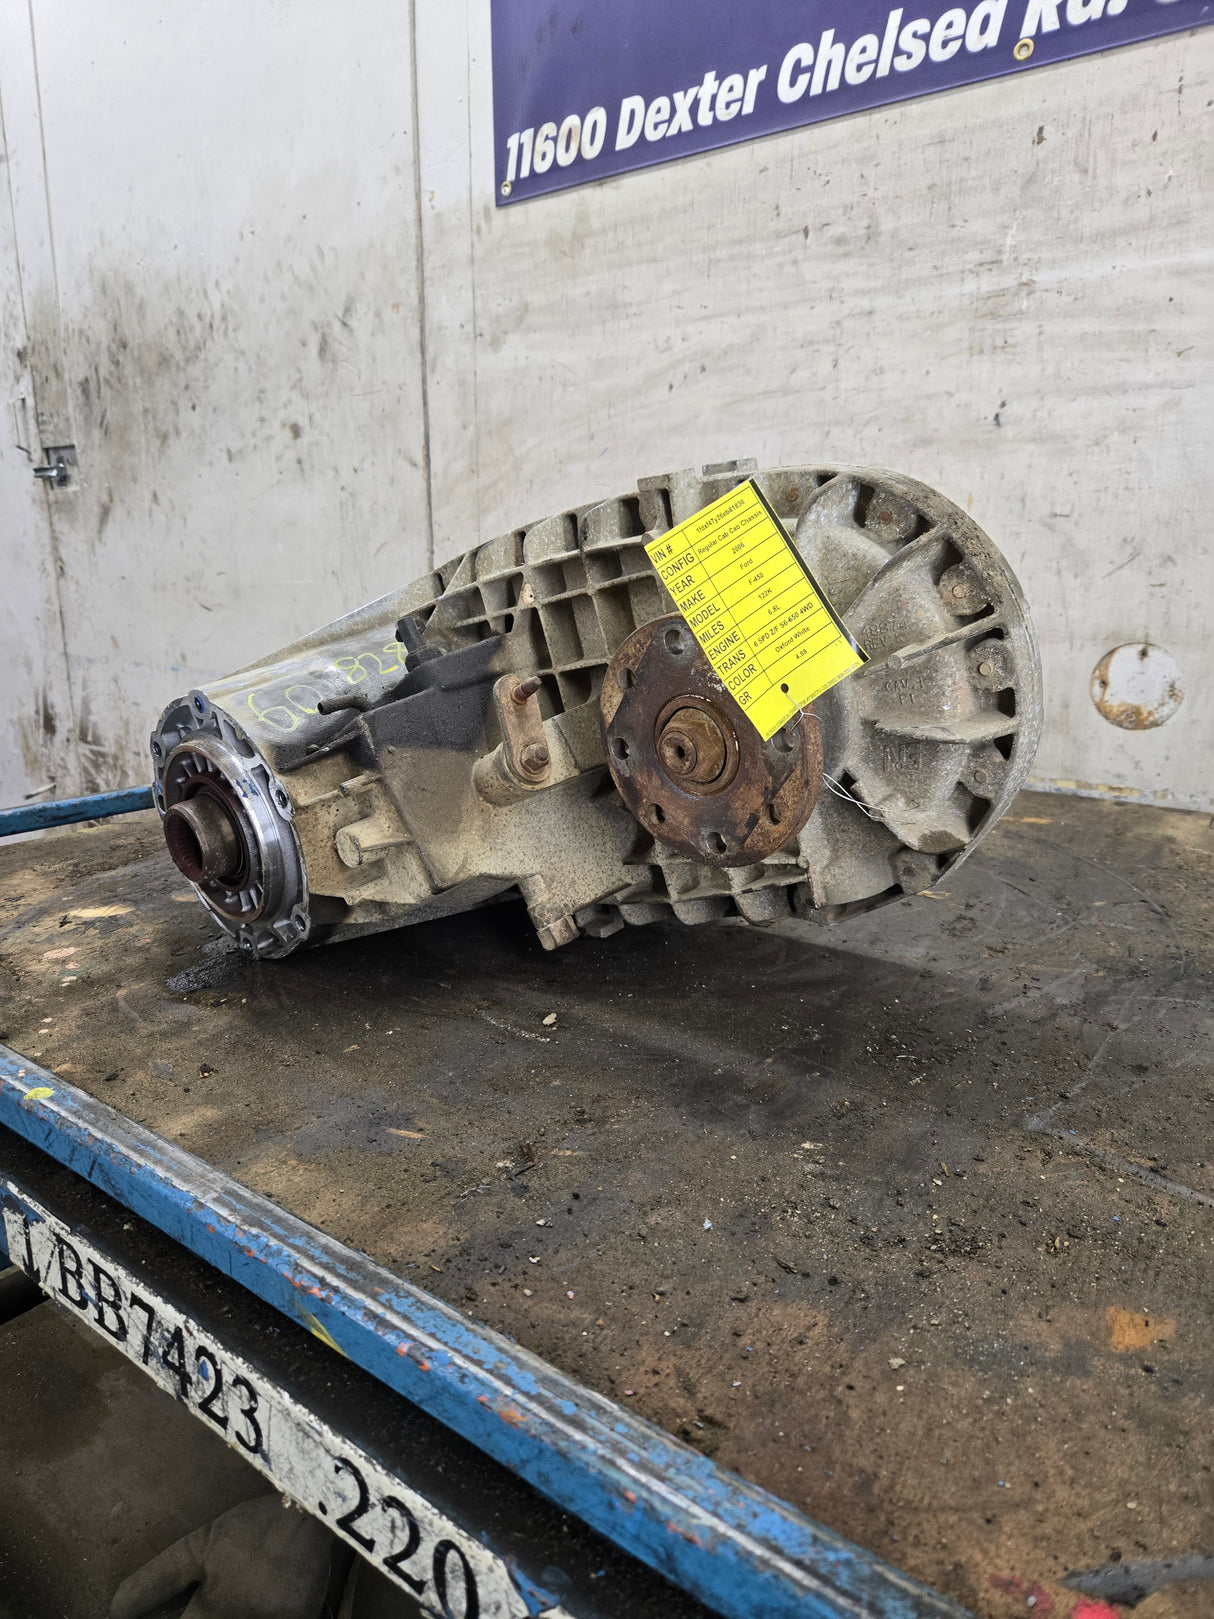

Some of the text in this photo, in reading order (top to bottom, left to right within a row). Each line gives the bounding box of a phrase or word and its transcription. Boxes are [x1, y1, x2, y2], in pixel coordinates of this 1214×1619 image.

[505, 106, 607, 183] 11600
[615, 64, 768, 152] Dexter
[776, 0, 1008, 104] Chelsea
[697, 510, 762, 555] Regular Cab Cab Chassis
[650, 543, 673, 565] VIN #
[731, 541, 745, 555] 2006
[660, 552, 695, 581] CONFIG
[739, 558, 754, 570] Ford
[670, 574, 695, 596] YEAR
[748, 572, 764, 585] F-450
[680, 589, 706, 613] MAKE
[758, 587, 773, 600] 122K
[689, 602, 720, 629] MODEL
[758, 632, 770, 644] SPD
[799, 602, 814, 615] 4WD
[699, 620, 725, 644] MILES
[775, 626, 810, 653] Oxford White
[707, 630, 740, 660] ENGINE
[717, 649, 746, 676] TRANS
[727, 663, 757, 691] COLOR
[738, 690, 753, 706] GR
